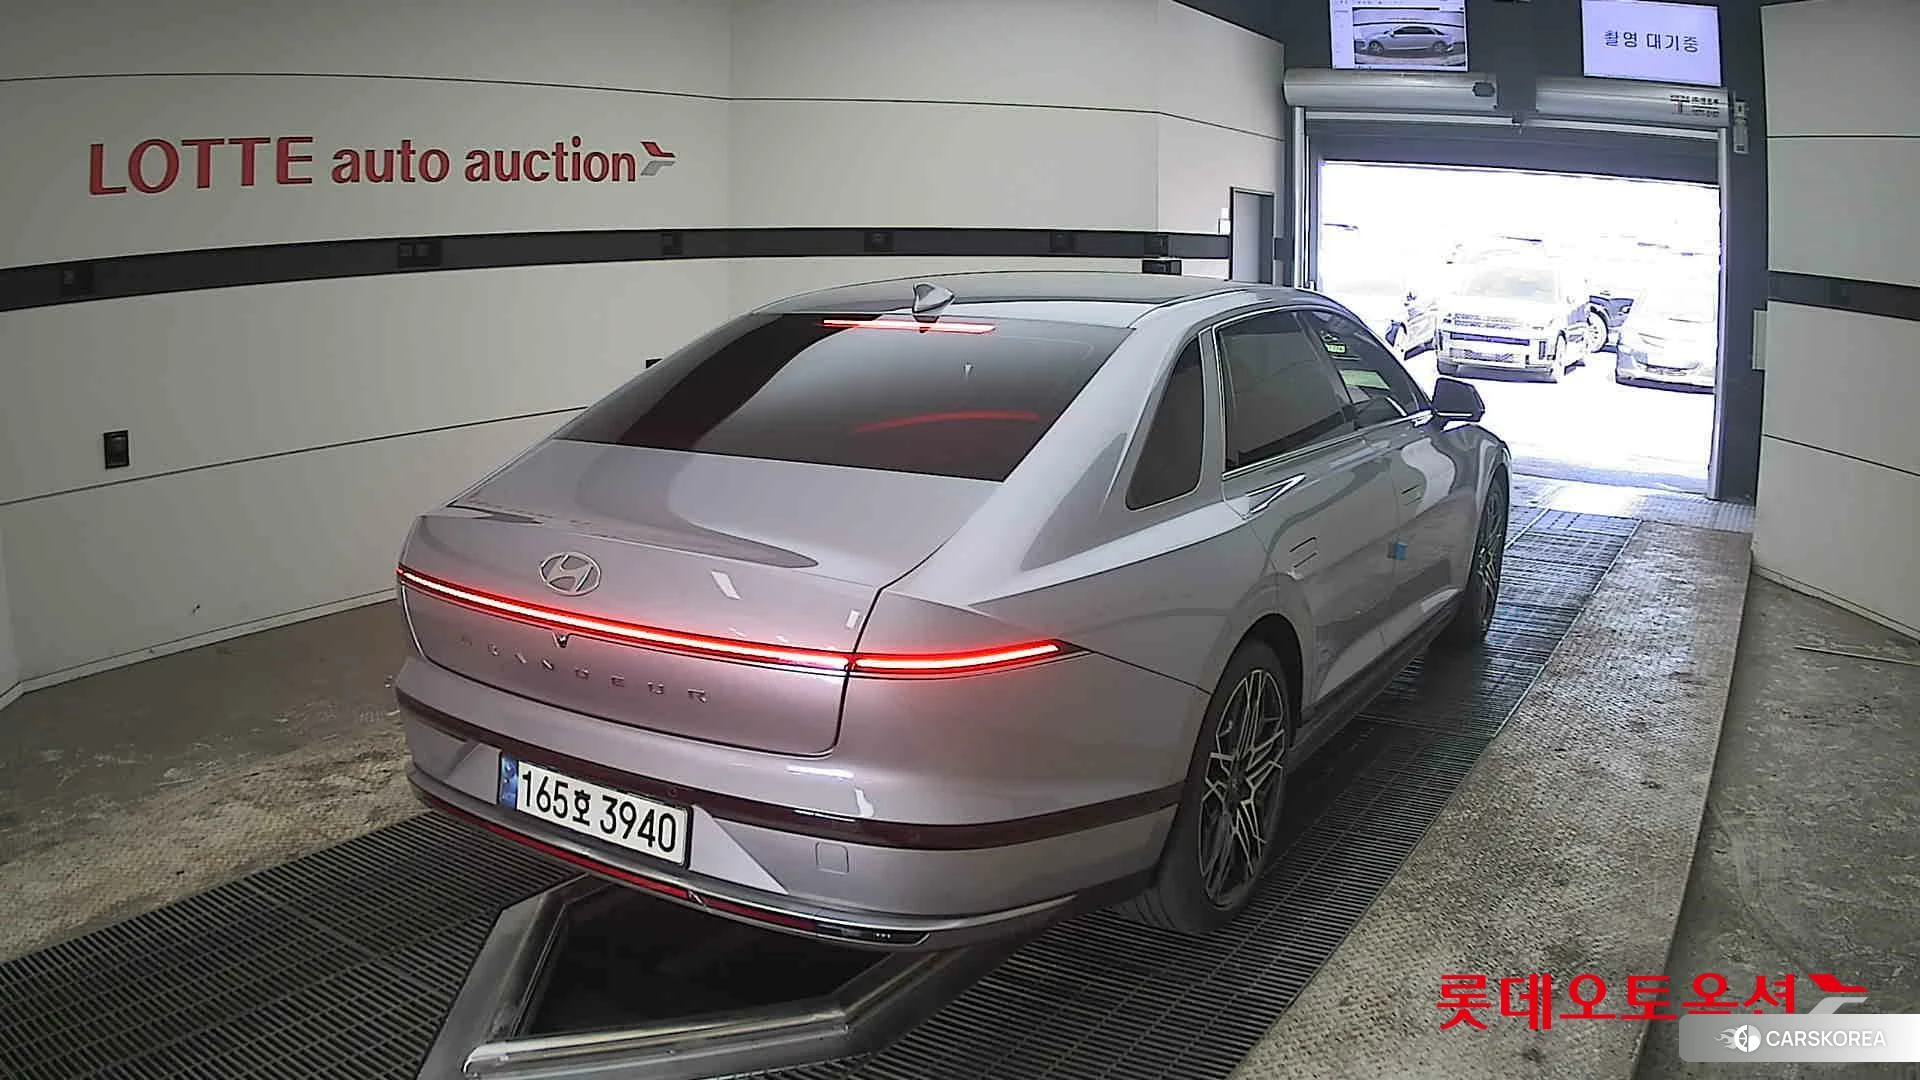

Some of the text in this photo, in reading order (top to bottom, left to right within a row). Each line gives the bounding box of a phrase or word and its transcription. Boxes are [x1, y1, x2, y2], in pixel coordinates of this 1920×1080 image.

[1646, 33, 1699, 53] 대기중
[89, 135, 637, 196] LOTTE auto auction
[522, 770, 677, 853] 165호 3940
